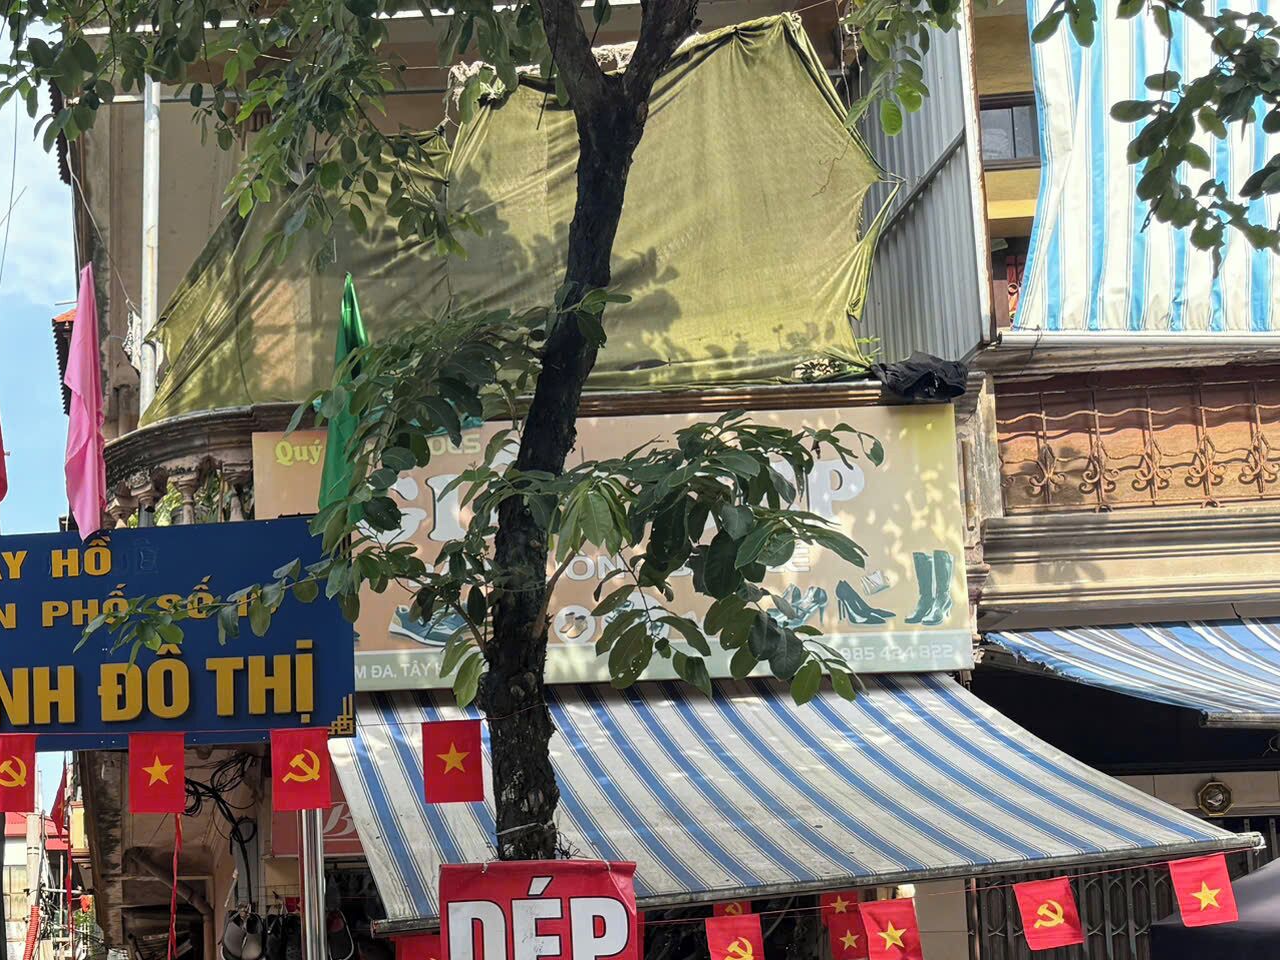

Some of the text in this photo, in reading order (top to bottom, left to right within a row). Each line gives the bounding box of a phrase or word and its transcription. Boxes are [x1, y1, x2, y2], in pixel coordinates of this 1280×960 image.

[275, 438, 323, 466] Quý
[41, 583, 129, 627] PHỐ
[841, 647, 876, 661] 985
[98, 643, 190, 723] ĐÔ
[206, 639, 314, 724] THỊ
[400, 660, 431, 677] TÂY
